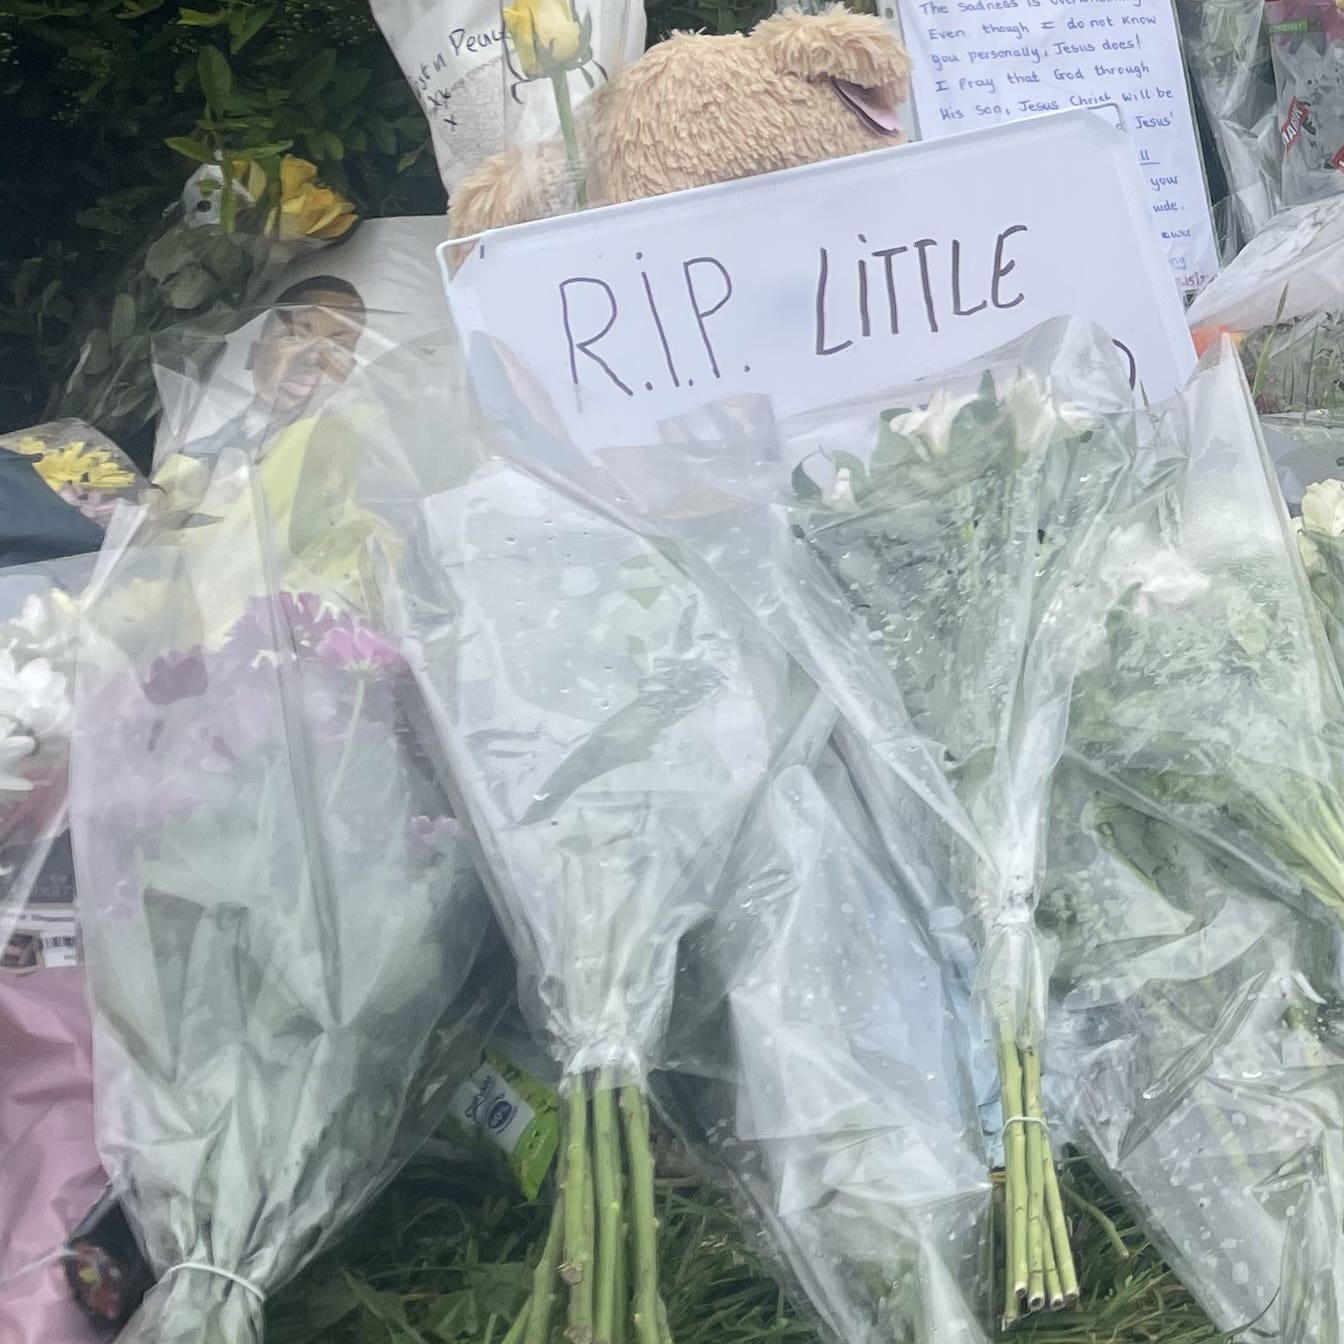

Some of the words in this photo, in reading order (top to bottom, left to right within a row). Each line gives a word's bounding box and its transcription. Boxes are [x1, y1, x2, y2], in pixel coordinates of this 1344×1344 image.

[919, 2, 949, 16] The
[928, 28, 966, 41] Even
[982, 21, 1030, 40] though
[1066, 17, 1085, 30] do
[1089, 16, 1115, 28] not
[930, 52, 960, 72] you
[1053, 41, 1097, 56] Jesus
[1101, 33, 1142, 51] does!
[935, 79, 950, 93] I
[1006, 70, 1040, 86] that
[1053, 67, 1085, 81] God
[1094, 64, 1151, 80] through
[940, 106, 965, 122] His
[1018, 99, 1059, 113] Jesus
[1069, 94, 1112, 109] Christ
[1156, 86, 1175, 99] be
